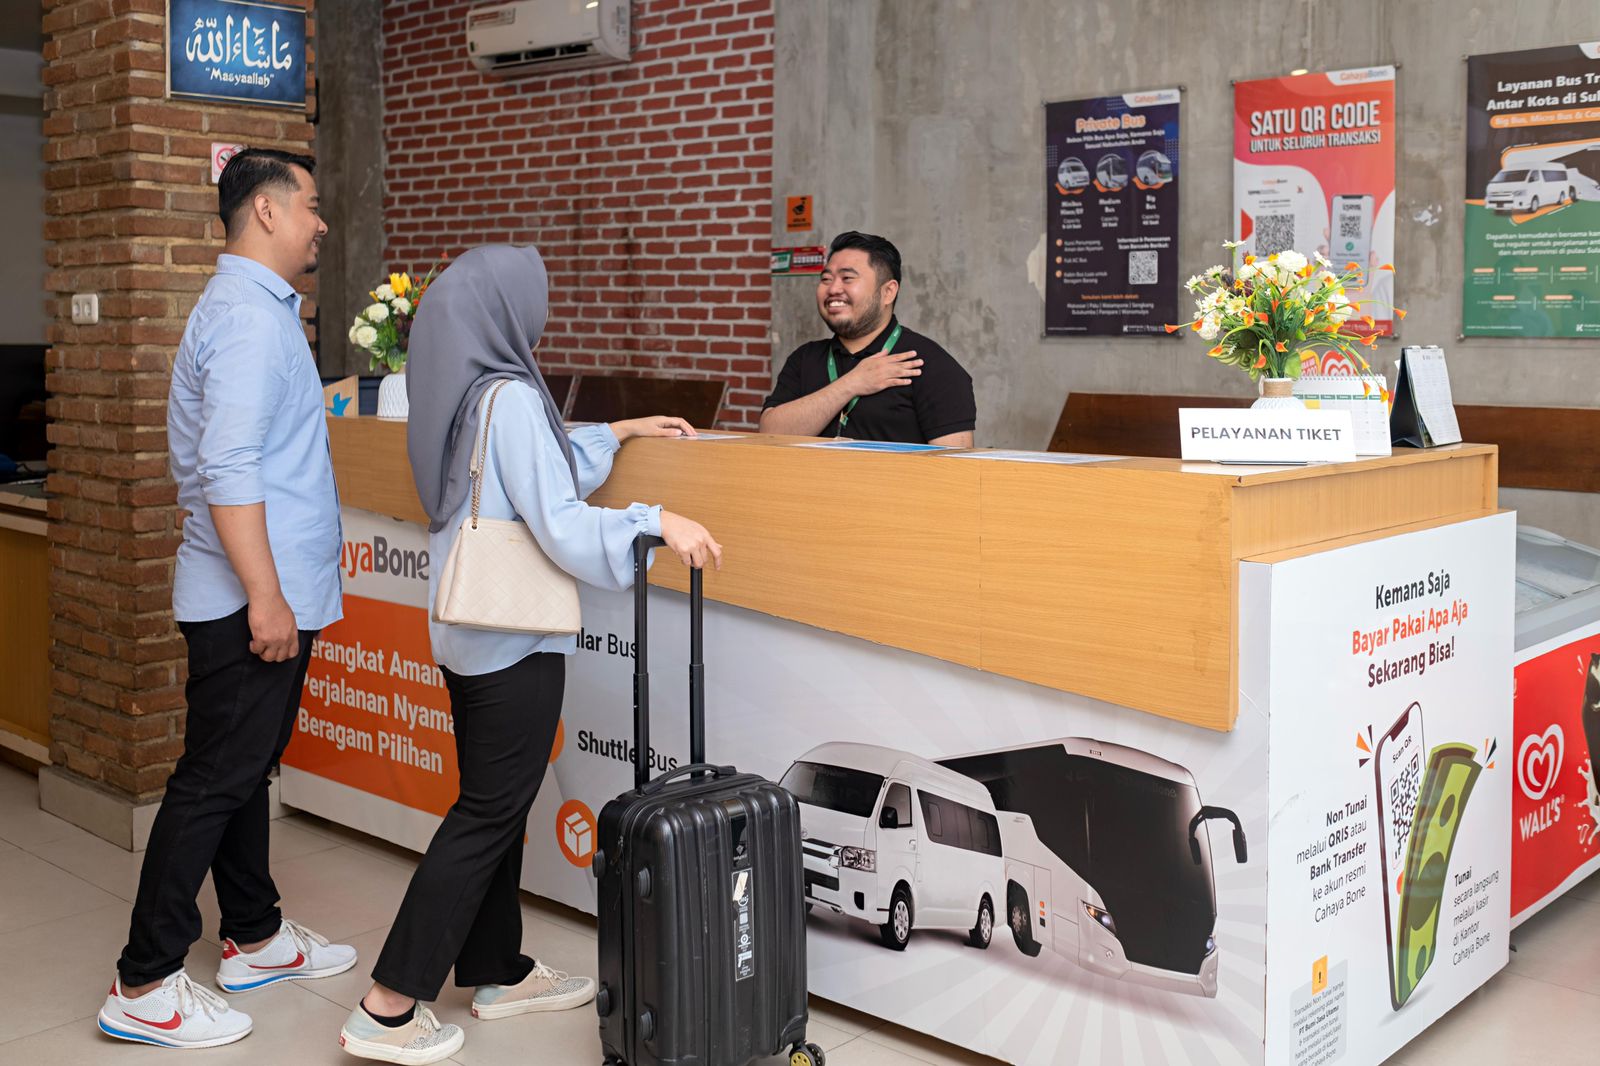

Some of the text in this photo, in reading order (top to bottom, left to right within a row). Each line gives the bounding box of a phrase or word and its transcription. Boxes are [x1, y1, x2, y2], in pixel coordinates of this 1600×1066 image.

[1487, 99, 1524, 110] Antar
[1528, 96, 1558, 107] Kota
[1563, 92, 1576, 104] di
[1498, 80, 1552, 94] Layanan
[1556, 76, 1582, 86] Bus
[1076, 113, 1146, 134] Private Bus
[1250, 100, 1381, 136] SATU QR CODE
[1250, 130, 1381, 153] UNTUK SELURUH TRANSAKSI
[1191, 427, 1341, 440] PELAYANAN TIKET
[1376, 569, 1450, 609] Kemana Saja
[1353, 599, 1468, 656] Bayar Pakai Apa Aja
[390, 651, 444, 689] Aman
[1368, 636, 1454, 688] Sekarang Bisa!
[298, 708, 443, 775] Beragam Pilihan
[1393, 747, 1403, 763] Scan
[1326, 795, 1367, 827] Non Tunai
[1296, 820, 1367, 864] melalui QRIS atau
[1310, 842, 1366, 880] Bank Transfer
[1455, 866, 1471, 887] Tunai
[1313, 860, 1366, 902] ke akun resmi
[1454, 870, 1499, 907] secara langsung
[1315, 886, 1365, 923] Cahaya Bone
[1454, 902, 1475, 926] melalui
[1453, 921, 1480, 946] di Kantor
[1453, 932, 1490, 965] Cahaya Bone
